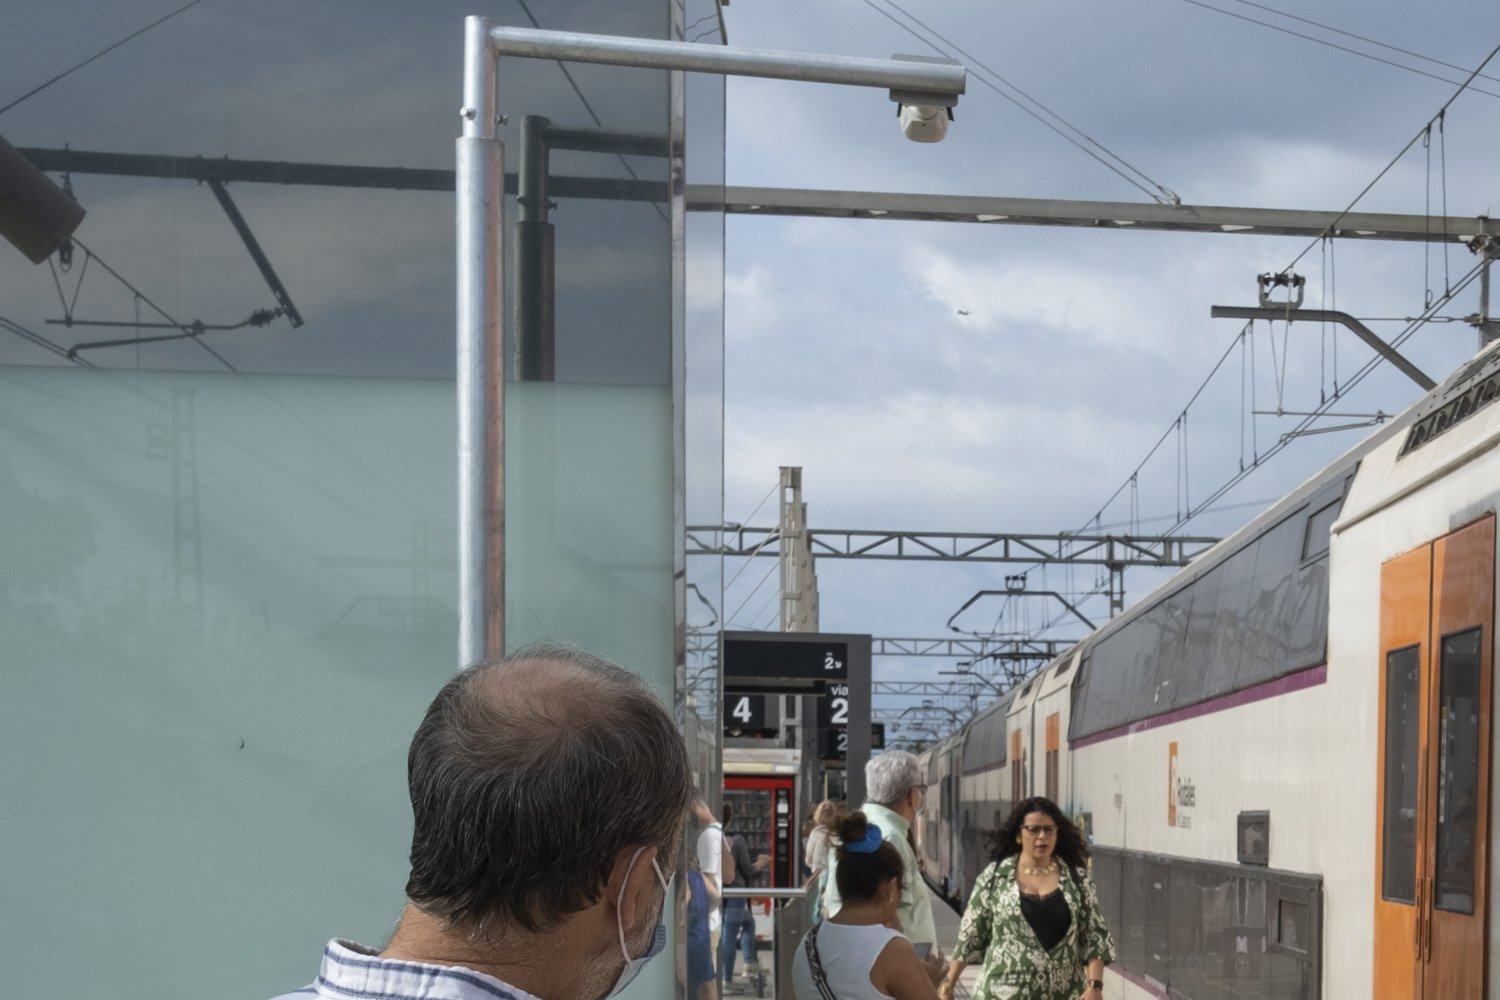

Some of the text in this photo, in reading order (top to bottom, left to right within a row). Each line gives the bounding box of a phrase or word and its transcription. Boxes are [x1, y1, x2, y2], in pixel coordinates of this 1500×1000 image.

[824, 657, 834, 669] 2
[733, 696, 752, 723] 4
[831, 698, 849, 724] 2
[837, 734, 848, 751] 2
